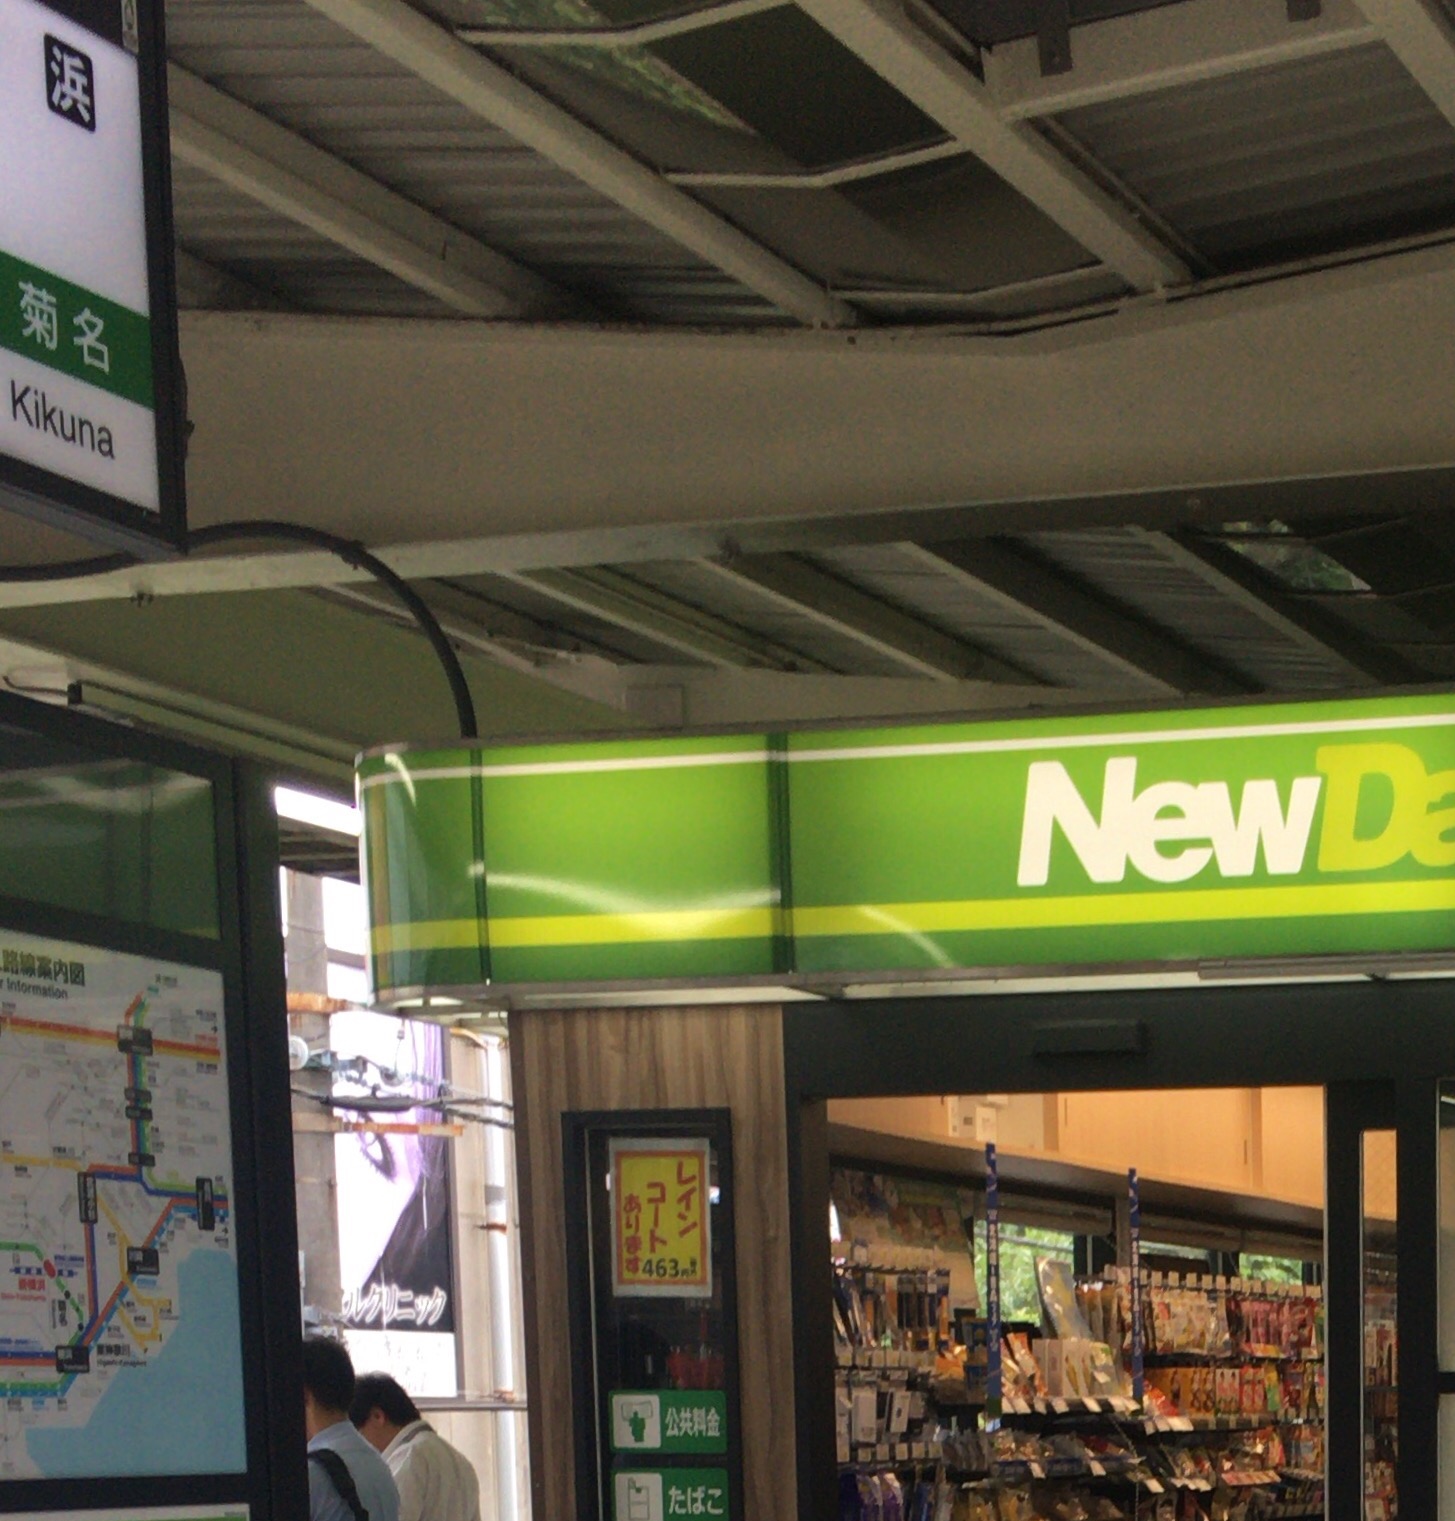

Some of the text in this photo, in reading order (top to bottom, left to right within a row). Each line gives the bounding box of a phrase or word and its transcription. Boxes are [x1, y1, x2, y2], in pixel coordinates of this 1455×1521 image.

[50, 47, 92, 124] 浜
[18, 281, 111, 376] 菊名
[10, 379, 116, 460] Kikuna
[646, 1181, 668, 1255] コート
[676, 1160, 699, 1238] レイン
[665, 1406, 721, 1437] 公共料金
[668, 1485, 724, 1515] たばこ
